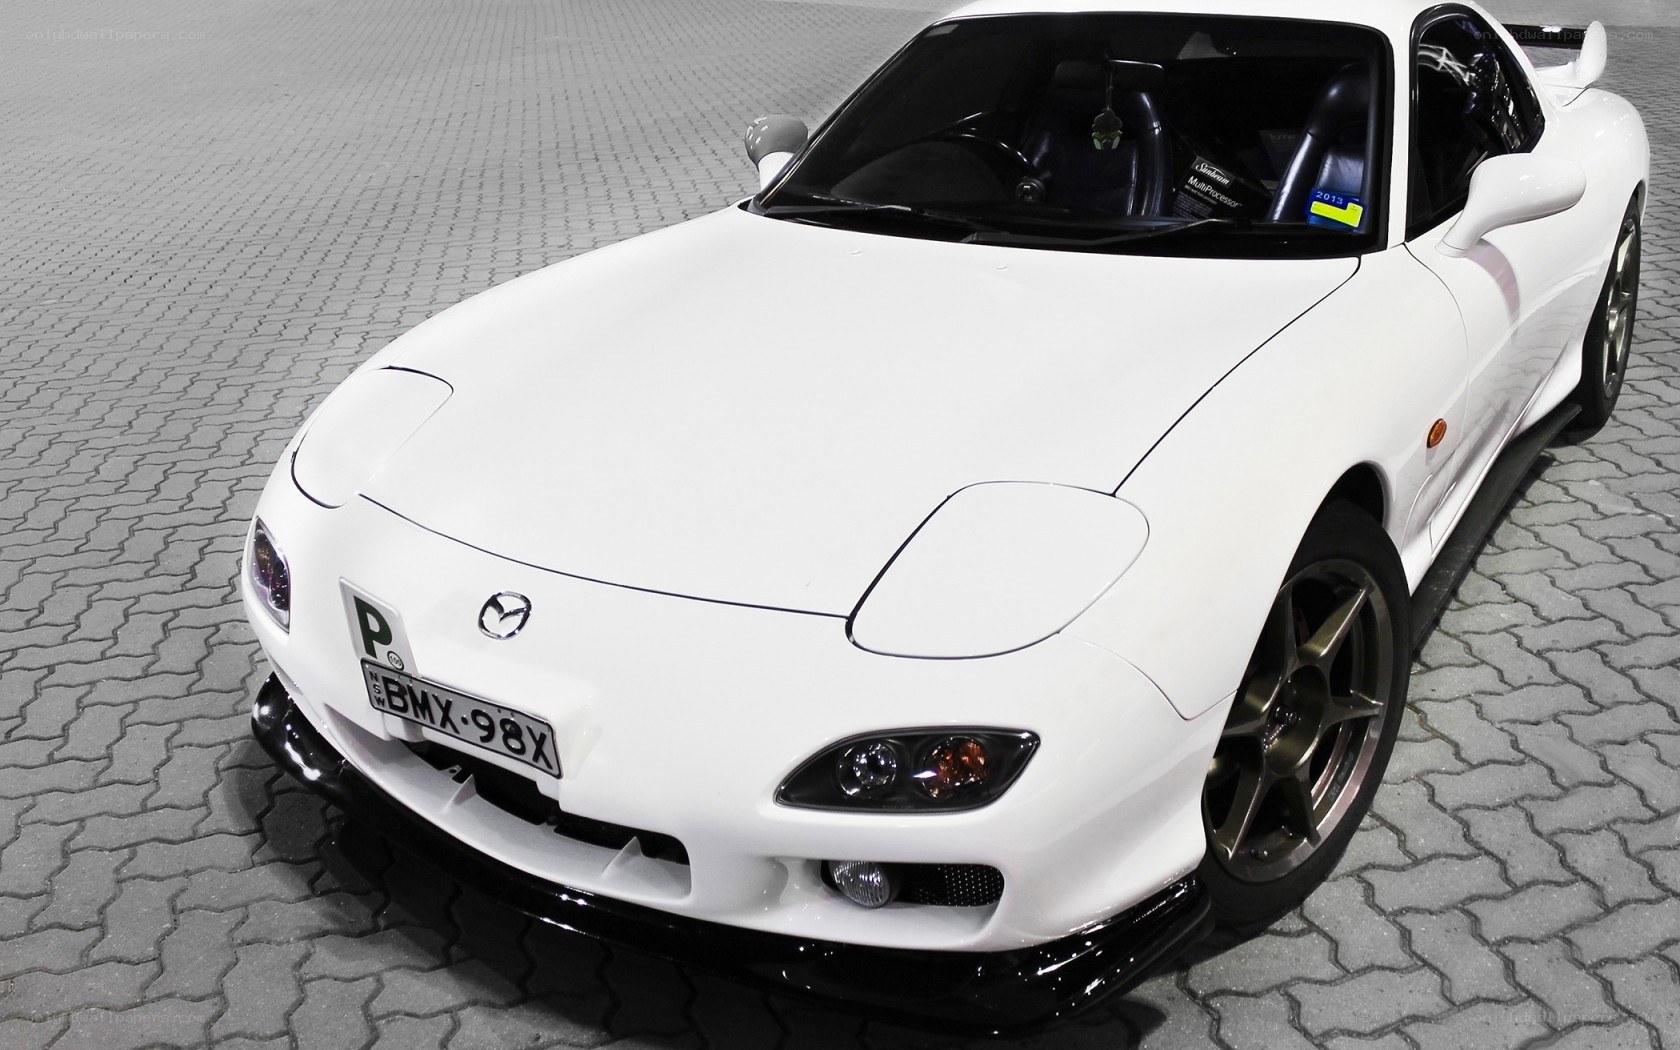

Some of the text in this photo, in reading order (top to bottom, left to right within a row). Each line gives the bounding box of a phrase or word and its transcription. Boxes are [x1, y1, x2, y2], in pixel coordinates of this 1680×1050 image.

[1195, 162, 1230, 185] Sunbeam
[1315, 191, 1344, 205] 2013
[353, 595, 393, 659] P
